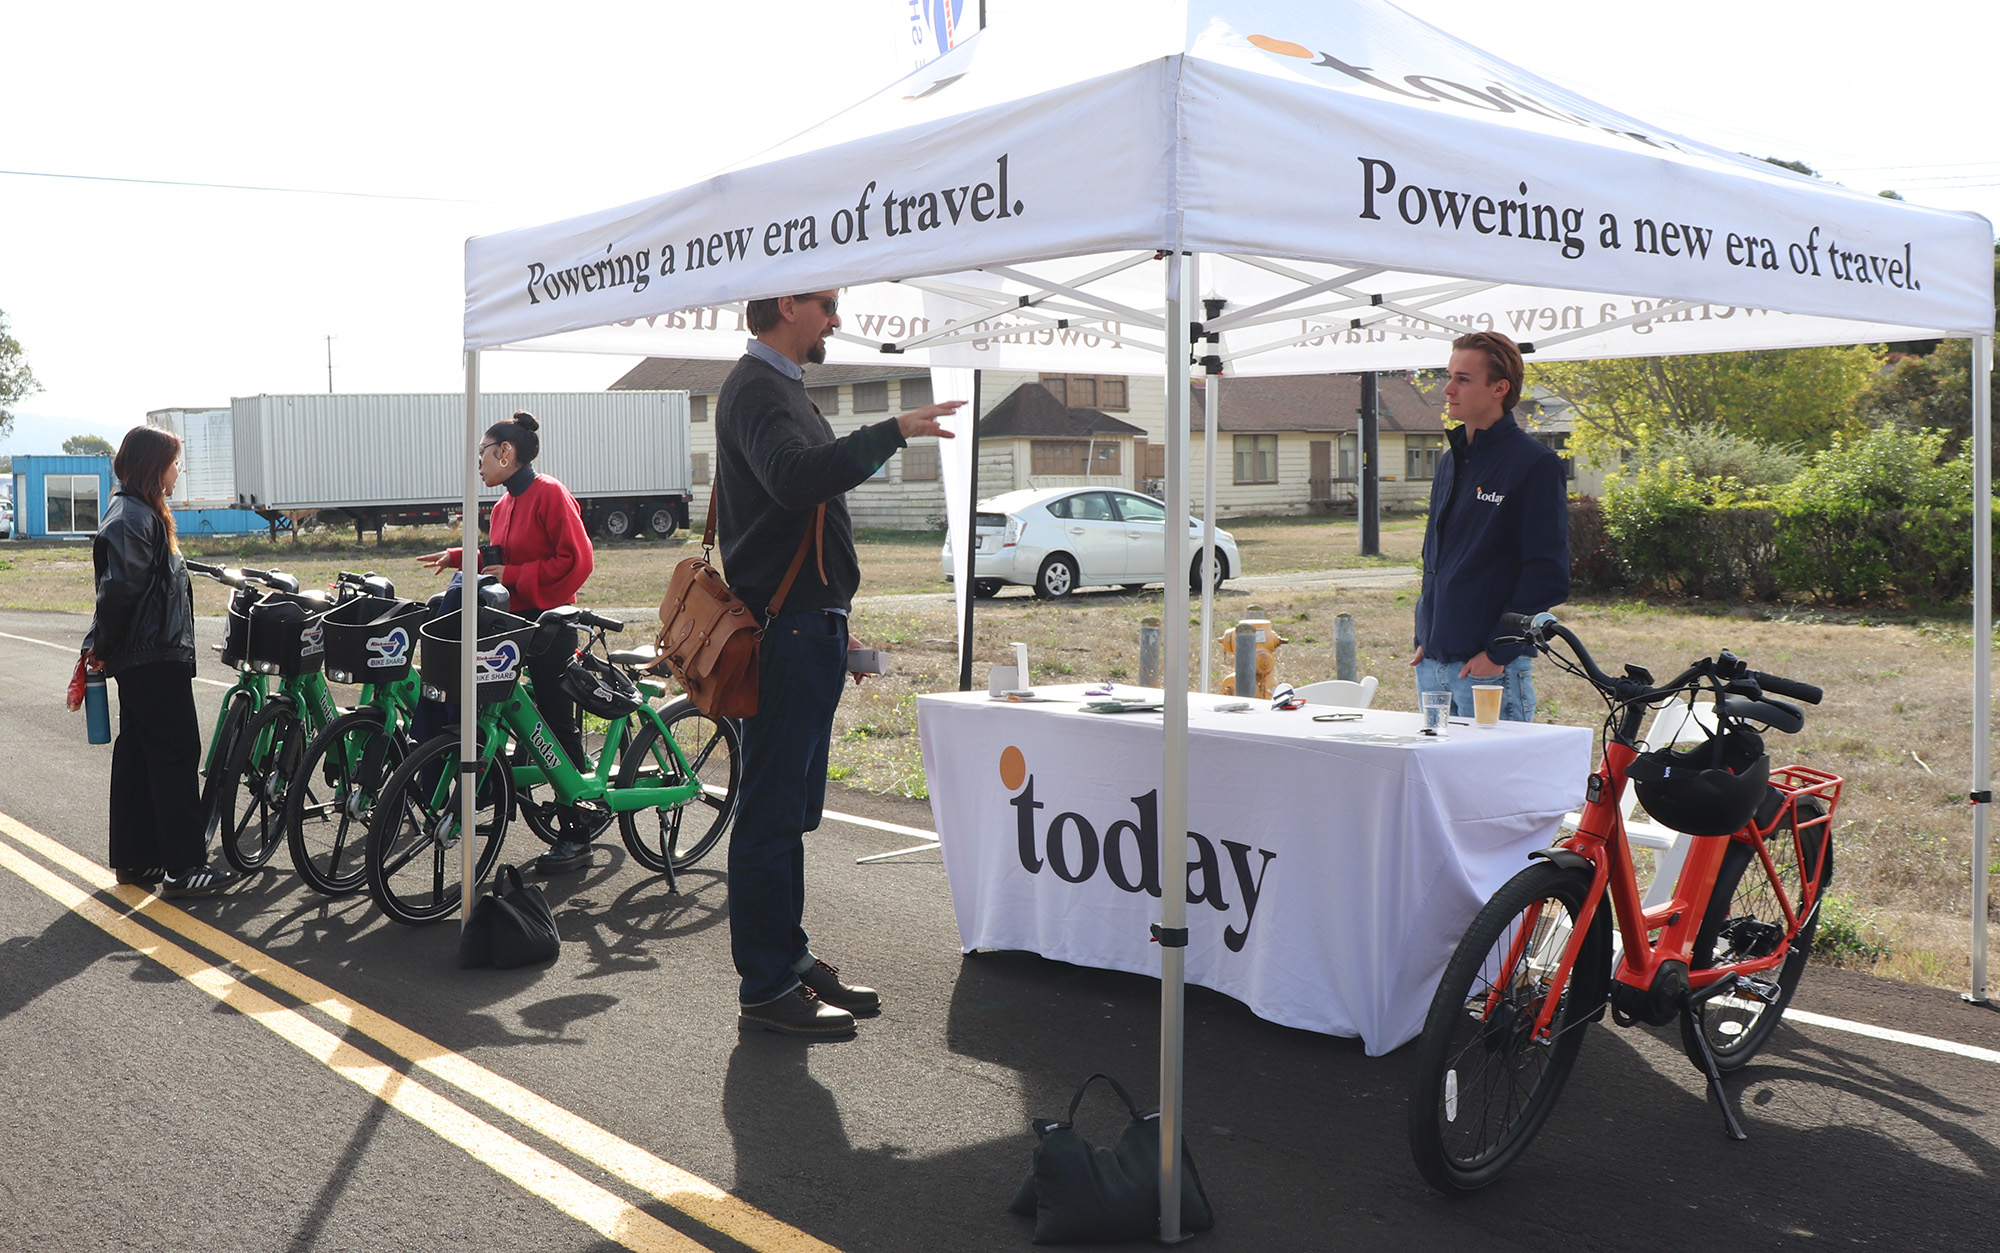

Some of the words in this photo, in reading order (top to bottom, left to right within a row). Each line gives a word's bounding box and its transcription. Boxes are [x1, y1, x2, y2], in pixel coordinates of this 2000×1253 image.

[528, 243, 651, 305] Powering
[661, 244, 676, 277] a
[685, 227, 754, 272] new
[764, 216, 819, 257] era
[831, 181, 877, 245] of
[883, 153, 1025, 238] travel.
[1358, 157, 1585, 260] Powering
[1600, 214, 1622, 250] a
[1634, 219, 1713, 261] new
[1726, 233, 1780, 271] era
[1789, 227, 1822, 277] of
[1828, 242, 1921, 291] travel.
[1476, 489, 1506, 506] today
[371, 659, 385, 667] BIKE
[386, 657, 405, 665] SHARE
[491, 672, 514, 680] SHARE
[531, 729, 561, 768] today
[1010, 773, 1277, 953] today
